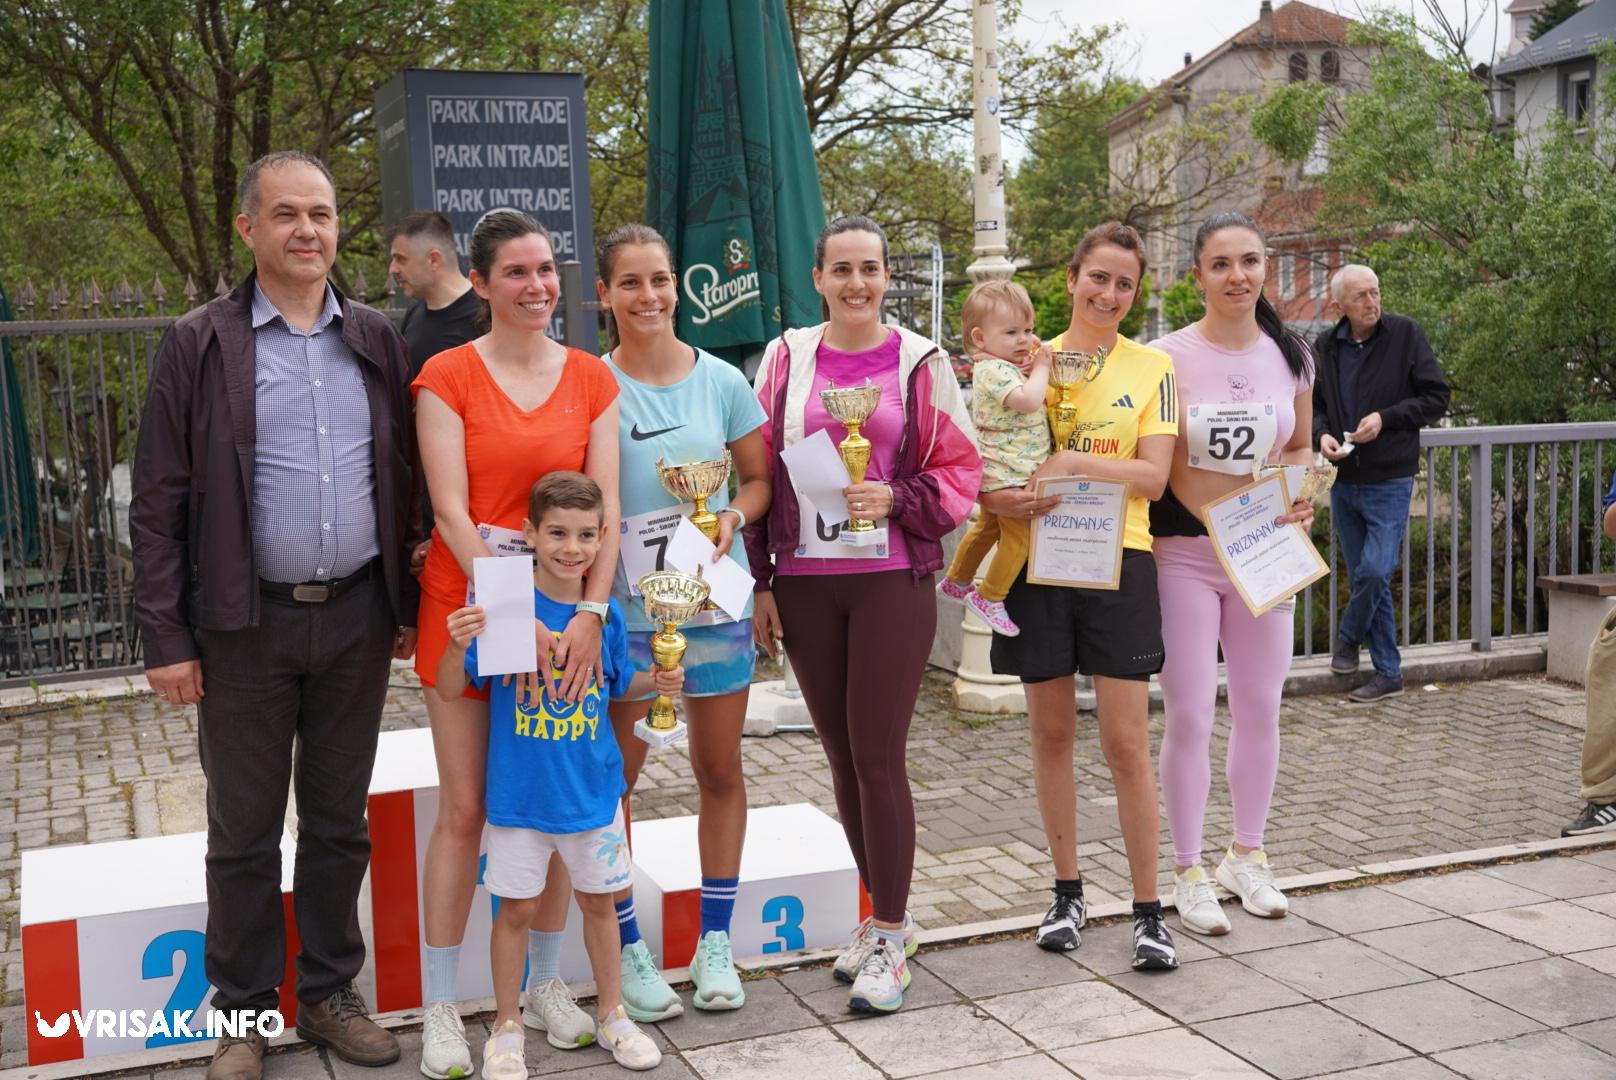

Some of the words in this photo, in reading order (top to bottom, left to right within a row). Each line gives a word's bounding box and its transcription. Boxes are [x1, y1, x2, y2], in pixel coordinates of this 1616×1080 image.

[431, 100, 480, 123] PARK
[434, 144, 484, 168] PARK
[436, 188, 485, 212] PARK
[1208, 426, 1255, 460] 52
[639, 527, 656, 535] POLOG
[647, 513, 682, 526] MINIMARATON
[1044, 514, 1114, 532] PRIZNANJE
[497, 543, 516, 552] POLOG
[515, 715, 599, 741] HAPPY
[762, 895, 805, 954] 3
[142, 929, 220, 1049] 2
